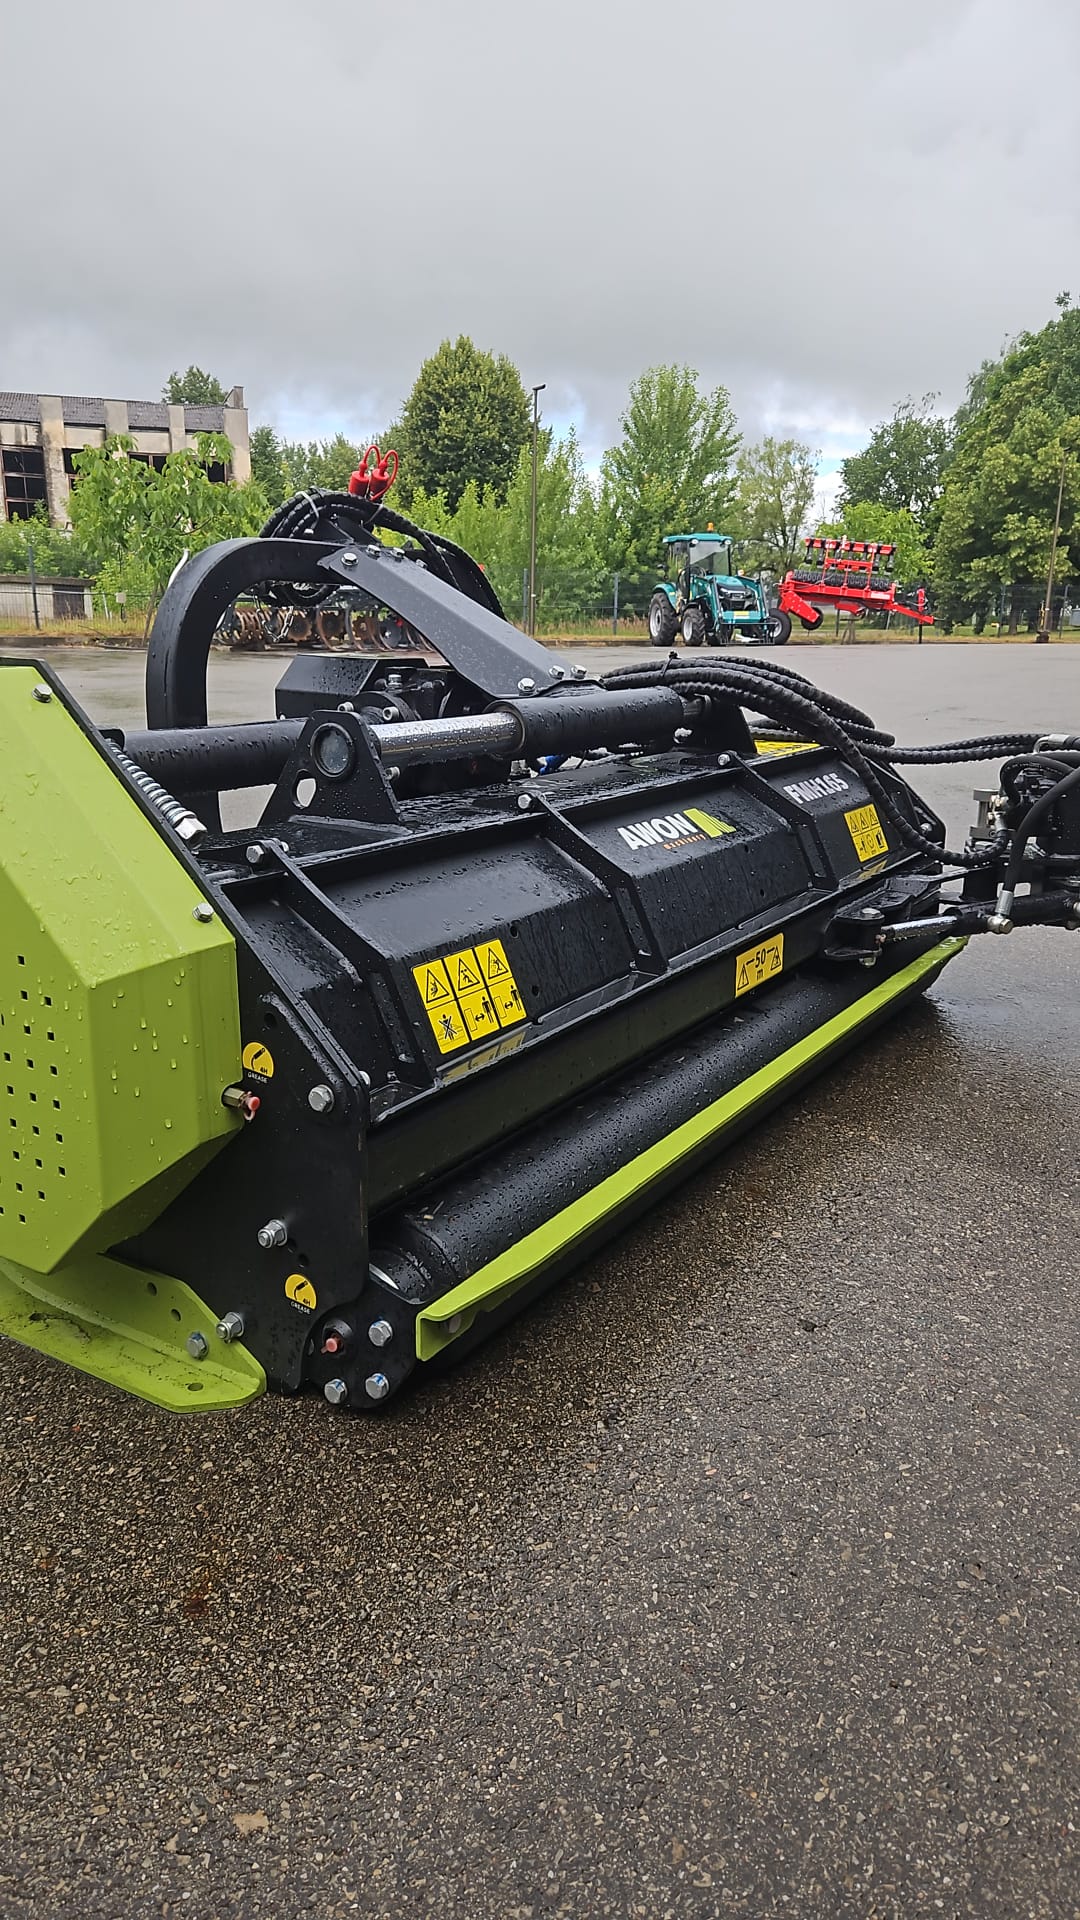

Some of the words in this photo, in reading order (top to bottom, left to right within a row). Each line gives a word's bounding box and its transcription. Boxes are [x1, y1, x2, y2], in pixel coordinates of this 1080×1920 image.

[783, 772, 849, 804] FMH165
[617, 813, 698, 850] AWON
[755, 948, 766, 968] 50
[247, 1071, 268, 1083] GREASE
[290, 1301, 310, 1314] GREASE
